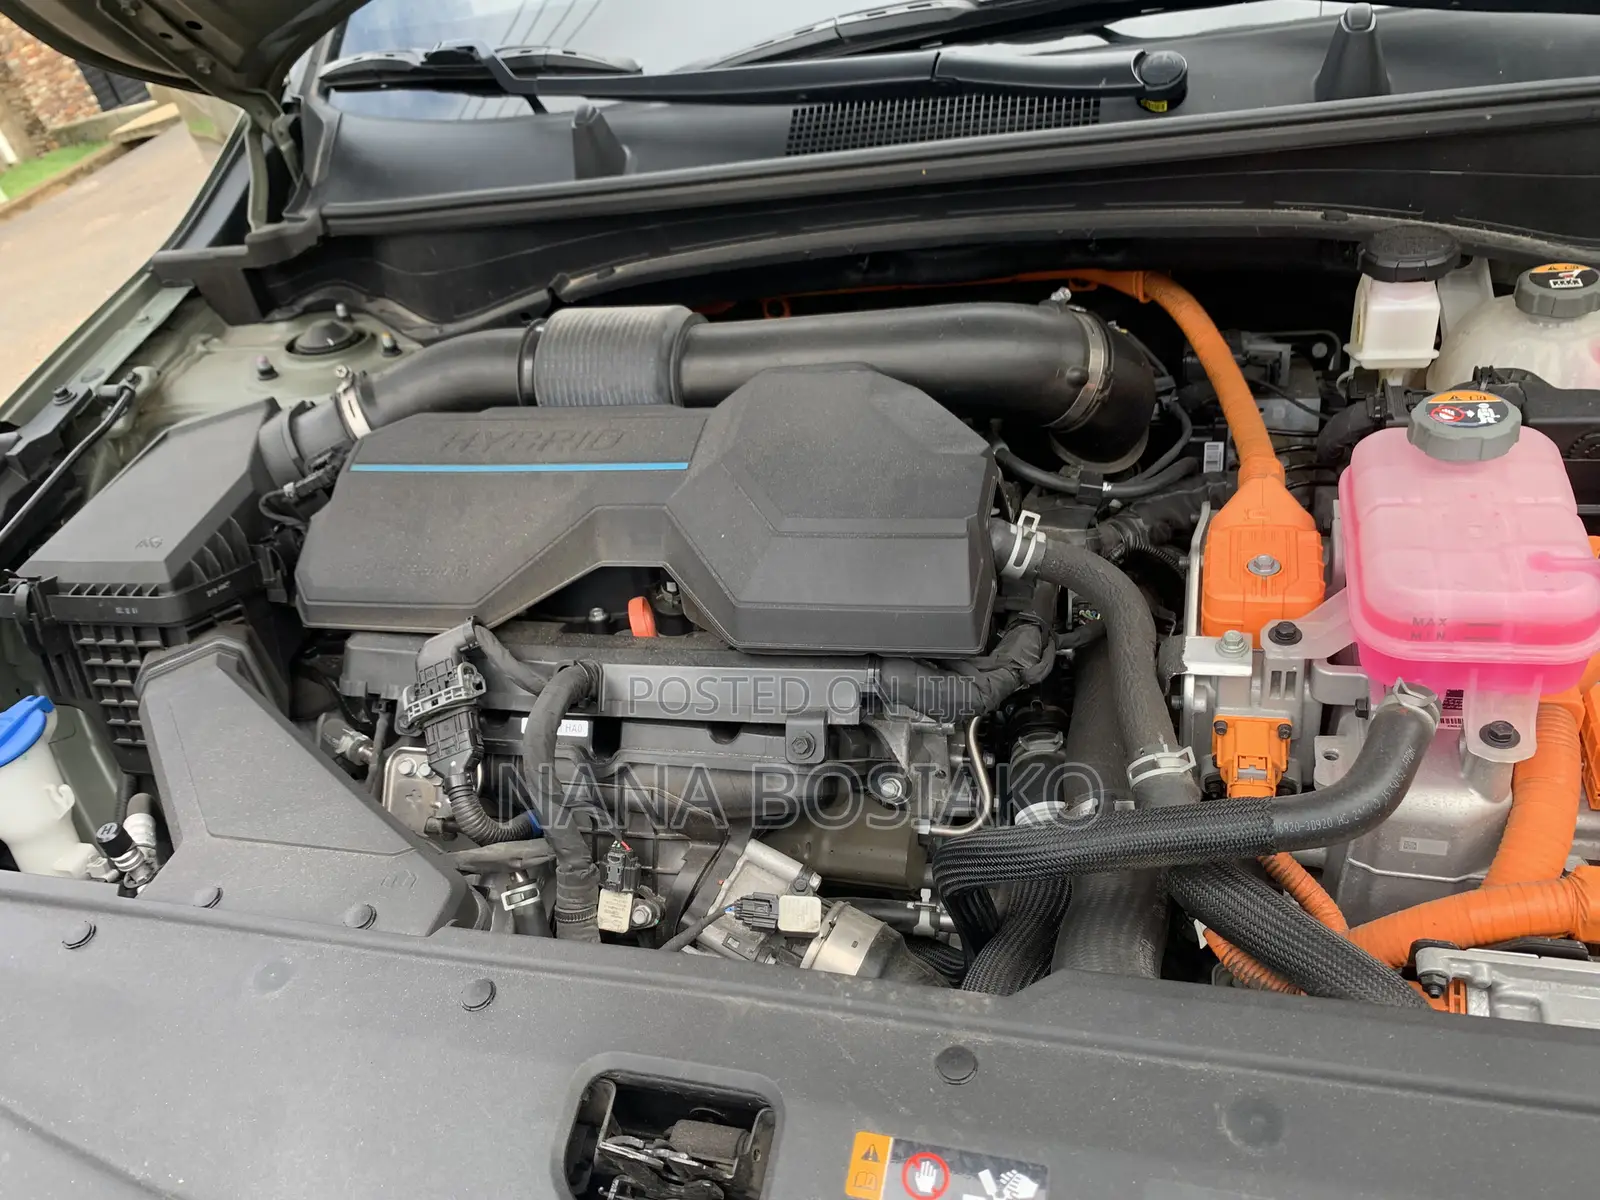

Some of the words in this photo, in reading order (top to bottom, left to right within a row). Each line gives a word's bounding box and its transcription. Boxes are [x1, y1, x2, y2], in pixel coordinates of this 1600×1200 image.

[439, 428, 626, 453] HYBRID
[1412, 616, 1448, 627] MAX
[1411, 631, 1446, 641] MIN
